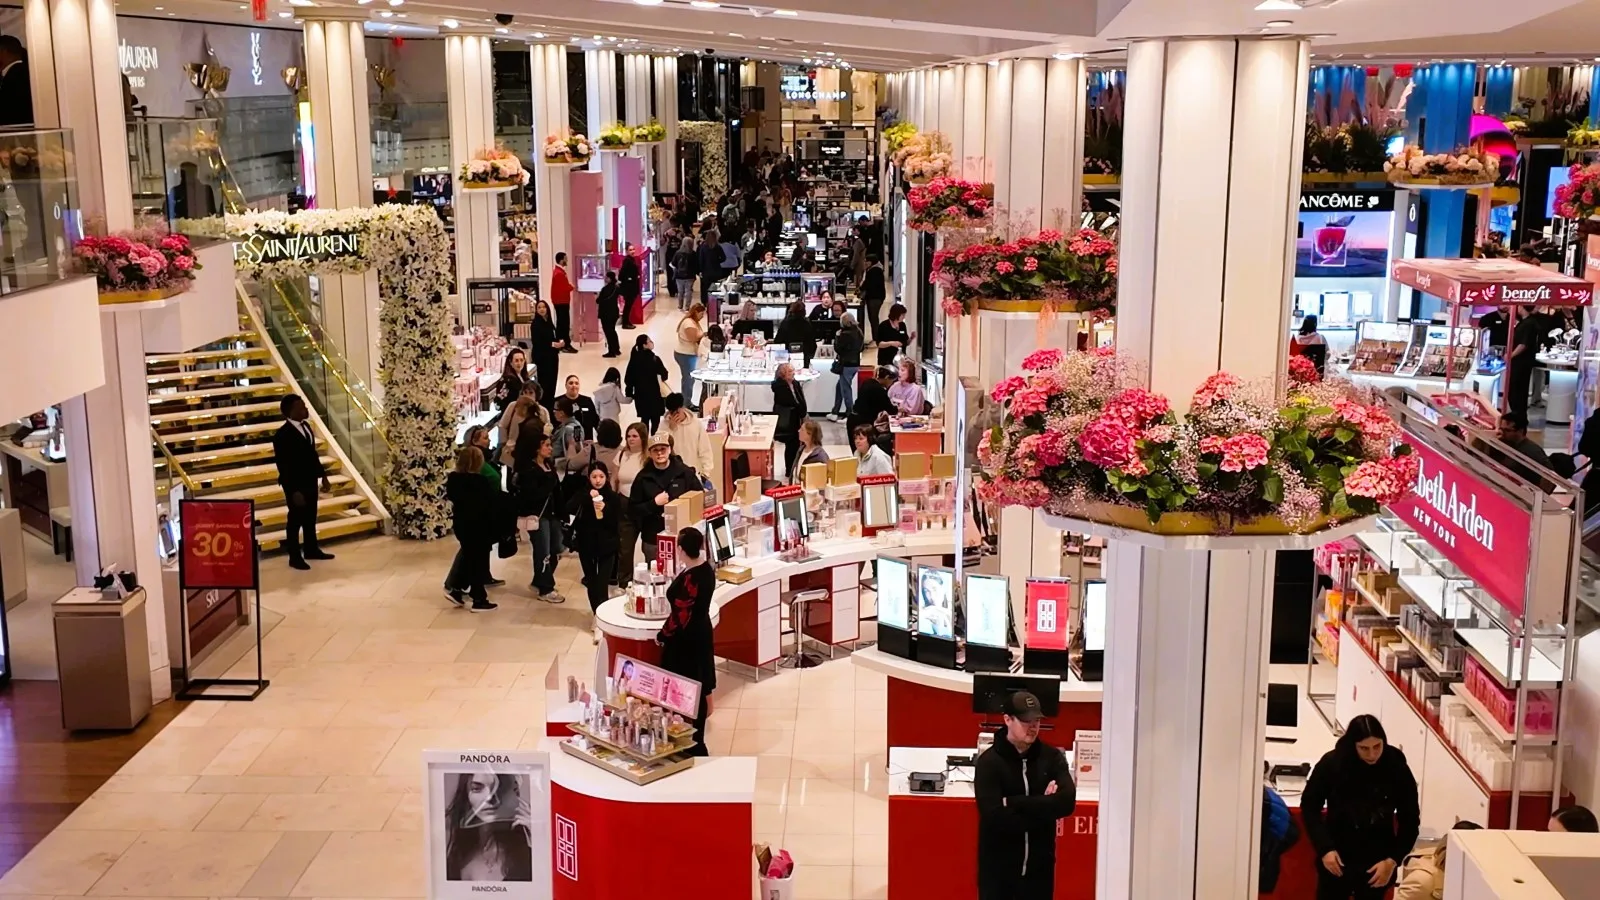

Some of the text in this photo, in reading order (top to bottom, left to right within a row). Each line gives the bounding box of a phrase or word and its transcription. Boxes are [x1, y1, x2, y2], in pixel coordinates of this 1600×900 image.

[785, 91, 847, 100] LONGCHAMP
[1298, 193, 1364, 208] ANCÔME
[294, 232, 360, 261] LAURENT
[1502, 285, 1551, 303] benefit
[1446, 481, 1495, 551] Arden
[1413, 505, 1456, 548] NEW YORK
[460, 753, 511, 763] PANDORA
[471, 885, 508, 893] PANDORA
